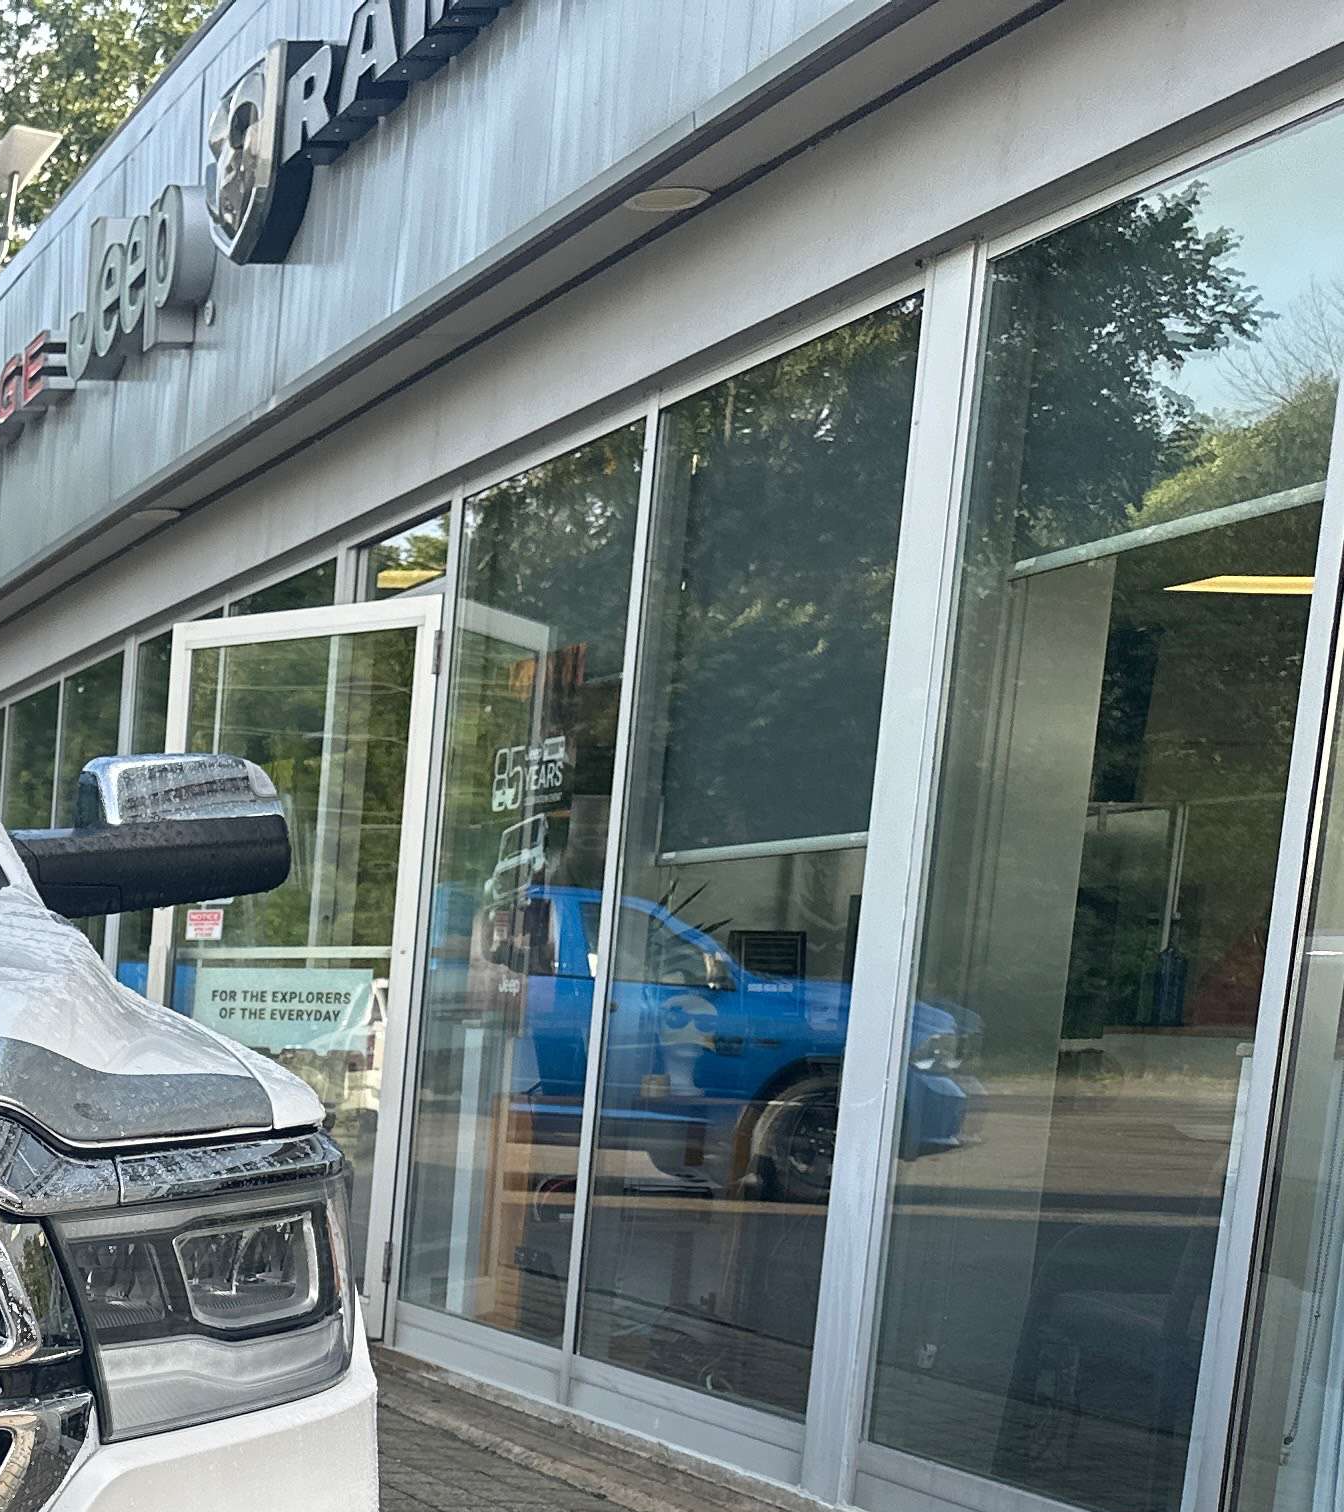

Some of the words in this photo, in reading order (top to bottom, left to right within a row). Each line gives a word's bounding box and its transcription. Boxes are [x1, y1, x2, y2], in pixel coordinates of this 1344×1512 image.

[67, 184, 185, 381] Jeep
[492, 745, 524, 812] 85
[524, 761, 564, 791] YEARS
[211, 989, 237, 1002] FOR
[243, 990, 268, 1003] THE
[272, 991, 352, 1005] EXPLORERS
[218, 1007, 235, 1020] OF
[241, 1007, 267, 1020] THE
[270, 1008, 342, 1022] EVERYDAY
